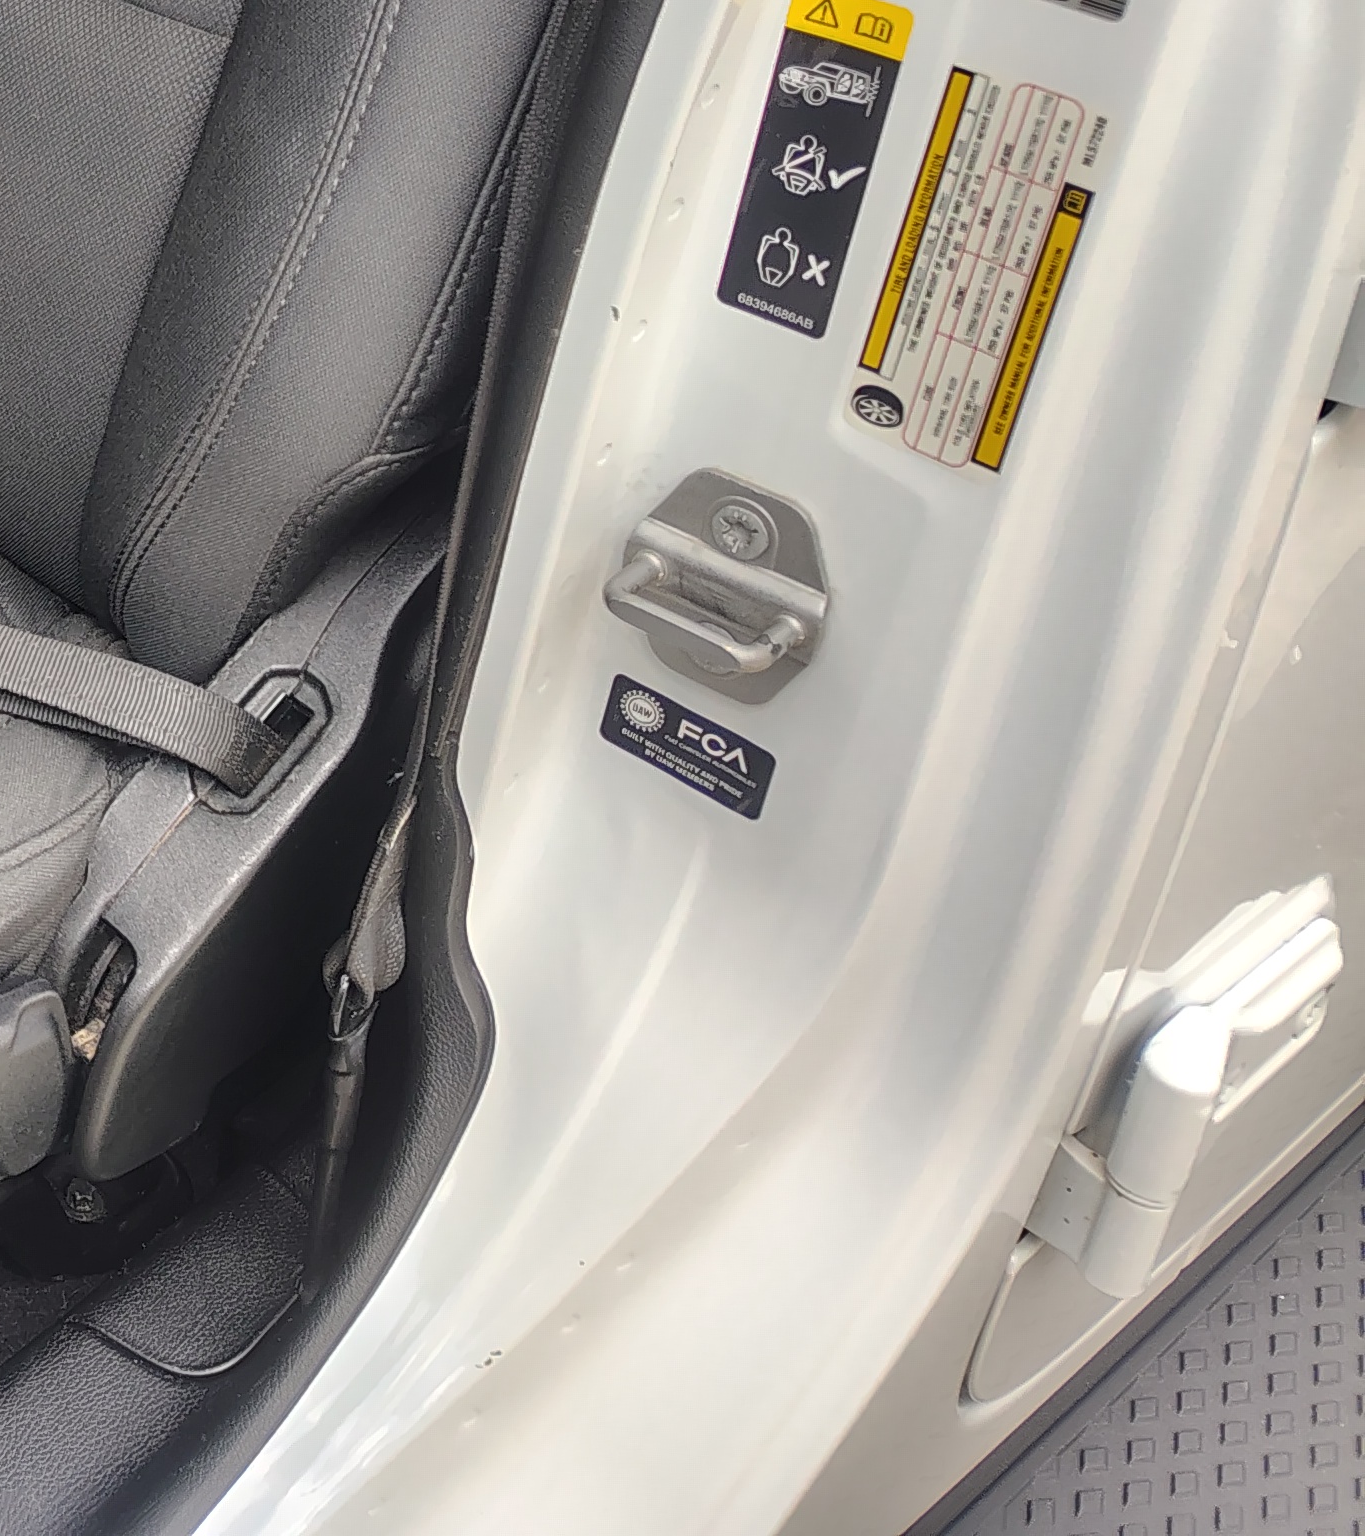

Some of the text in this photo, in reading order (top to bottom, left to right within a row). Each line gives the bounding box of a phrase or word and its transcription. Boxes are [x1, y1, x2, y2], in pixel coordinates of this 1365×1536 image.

[915, 152, 944, 214] INFORMATION
[903, 214, 925, 253] LOADING
[897, 254, 912, 273] AND
[890, 273, 905, 294] TIRE
[735, 291, 815, 330] 68394686AB
[630, 701, 653, 719] UAW
[672, 717, 756, 775] FCA
[643, 748, 655, 758] BY
[654, 754, 675, 769] UAW
[664, 750, 701, 774] QUALITY
